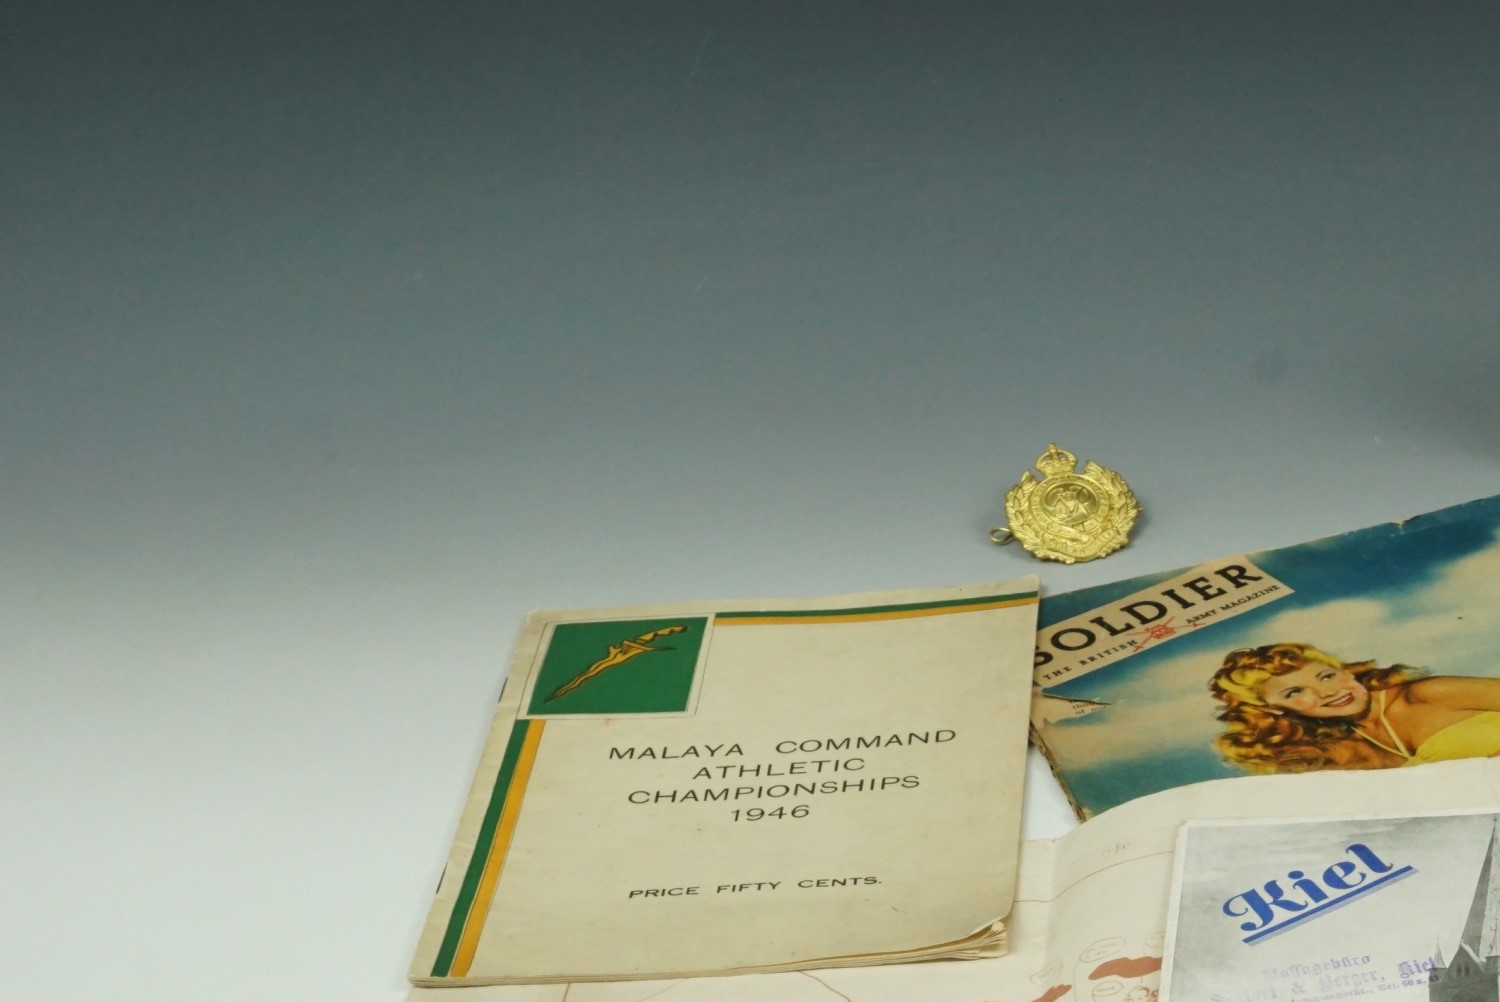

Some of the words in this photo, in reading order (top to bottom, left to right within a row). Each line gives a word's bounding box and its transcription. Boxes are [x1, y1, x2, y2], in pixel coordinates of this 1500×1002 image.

[1043, 666, 1072, 680] THE
[1081, 639, 1138, 666] BRITISH
[1185, 612, 1217, 625] ARMY
[1220, 585, 1280, 611] MAGAZINE
[610, 744, 743, 759] MALAYA
[776, 730, 956, 754] COMMAND
[693, 758, 865, 780] ATHLETIC
[628, 776, 920, 804] CHAMPIONSHIPS
[731, 805, 810, 822] 1946
[629, 886, 700, 898] PRICE
[717, 881, 781, 894] FIFTY
[798, 876, 882, 889] CENTS.
[1221, 843, 1394, 932] Kiel
